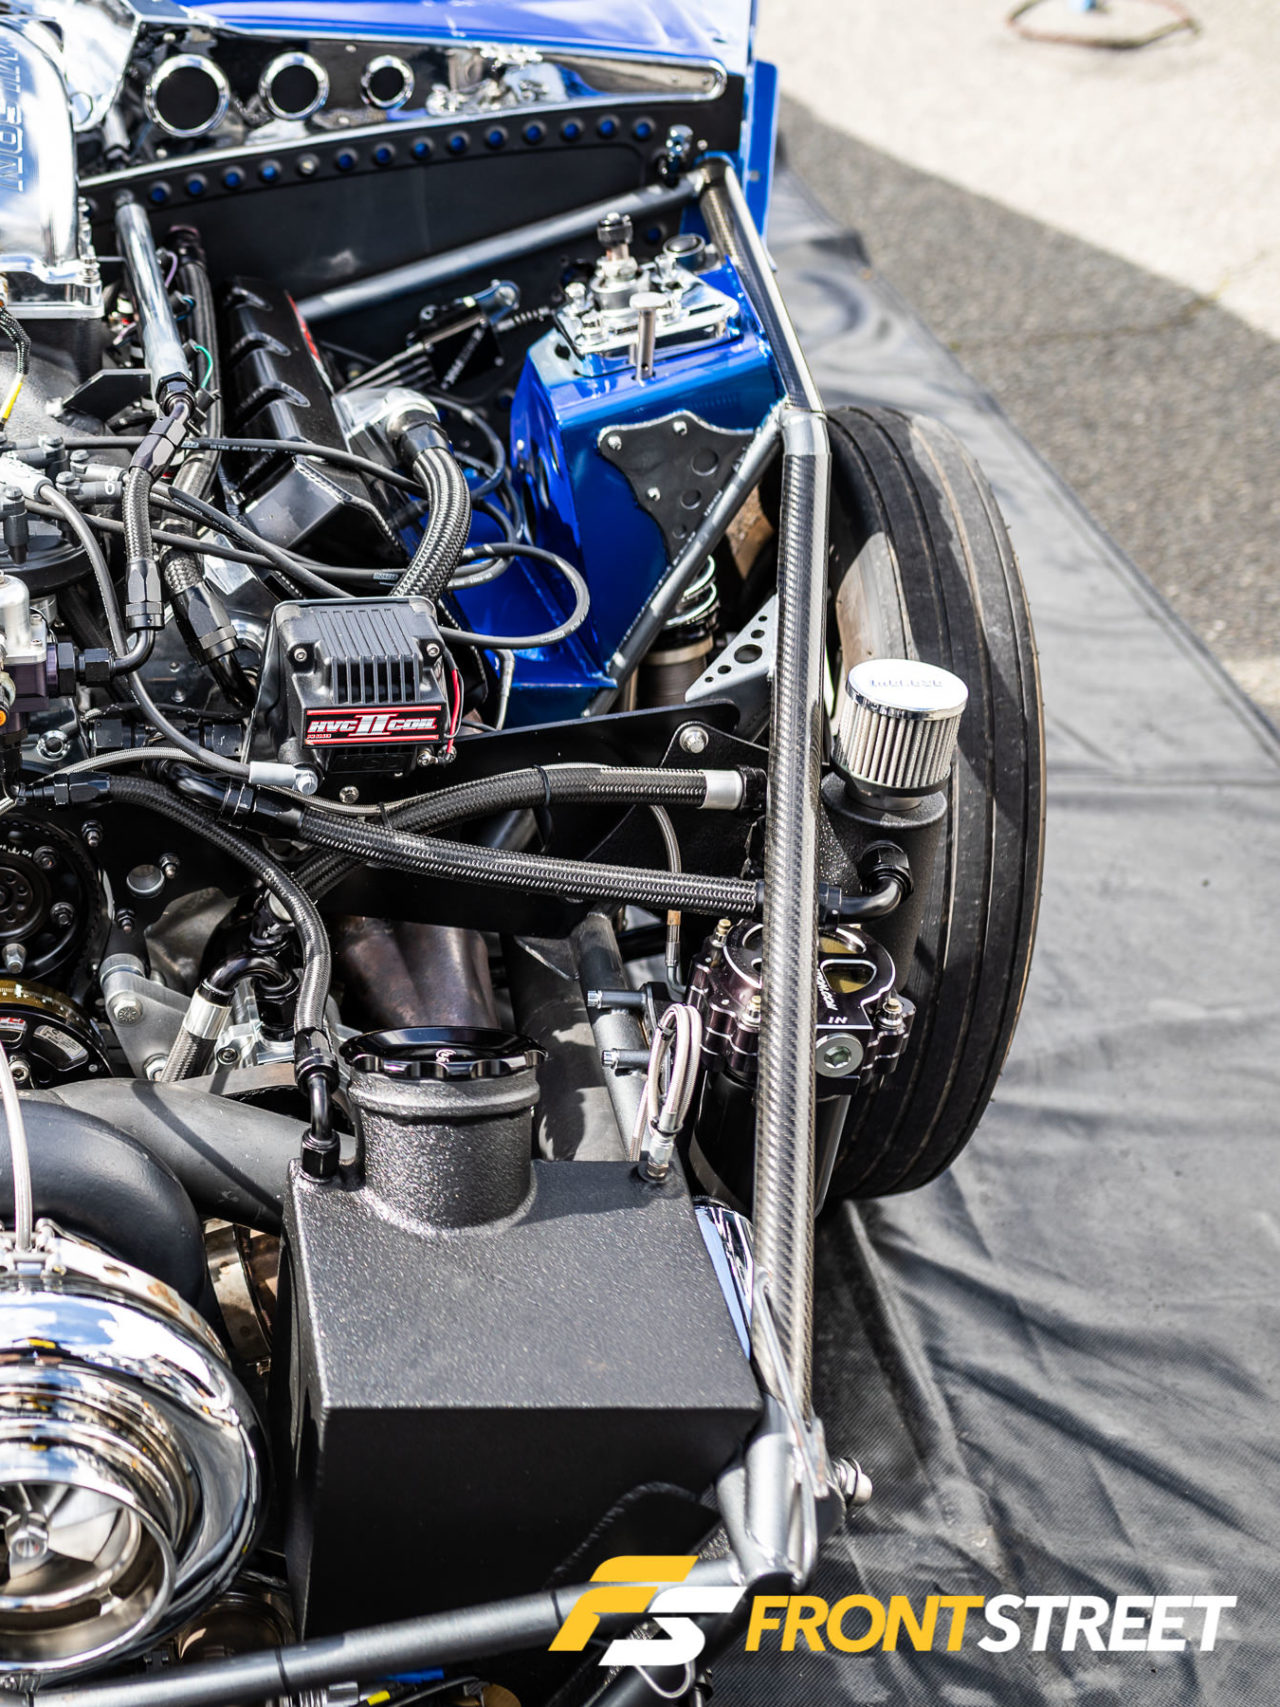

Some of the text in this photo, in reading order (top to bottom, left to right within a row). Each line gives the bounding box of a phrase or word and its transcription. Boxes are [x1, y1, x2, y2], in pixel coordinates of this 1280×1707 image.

[307, 719, 359, 733] HVC
[386, 717, 438, 731] COIL
[828, 1016, 848, 1024] IN
